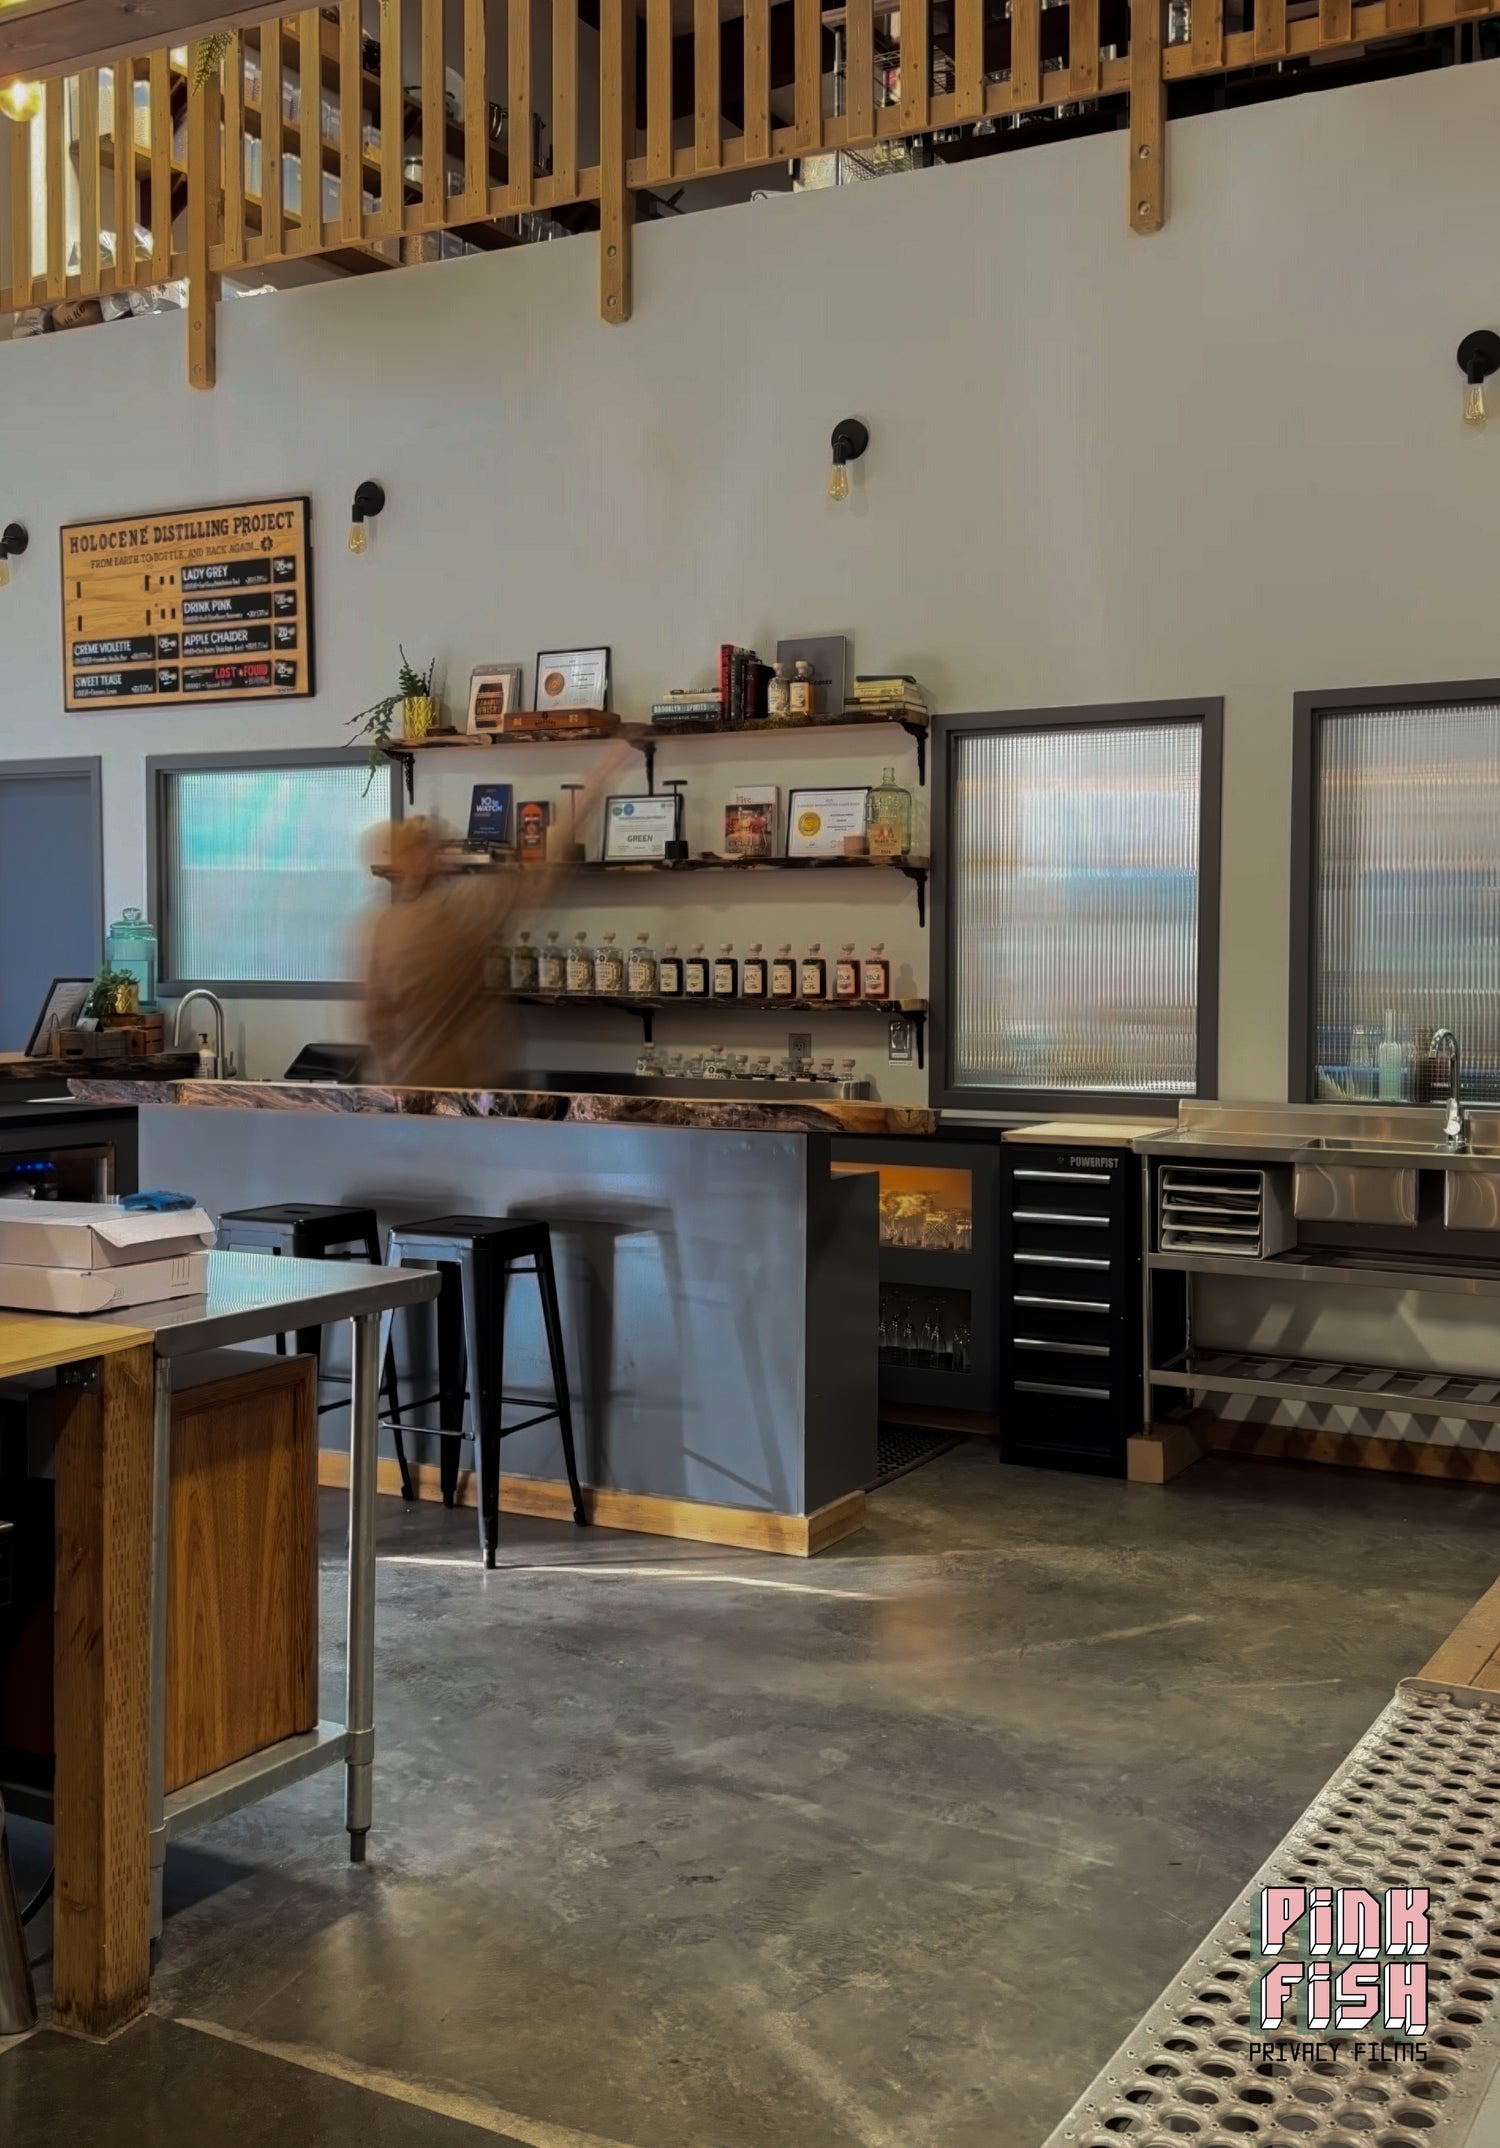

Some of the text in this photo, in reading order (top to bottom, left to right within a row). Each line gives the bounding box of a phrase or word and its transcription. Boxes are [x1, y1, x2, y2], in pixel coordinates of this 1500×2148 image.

[70, 511, 294, 554] HOLOCENE DISTILLING PROJECT
[91, 557, 112, 569] FROM
[189, 547, 204, 559] AND
[206, 545, 227, 556] BACK
[182, 564, 229, 581] LADY GREY
[183, 598, 233, 614] DRINK PINK
[184, 629, 248, 646] APPLE CHAIDER
[99, 640, 132, 653] VIOLETTE
[215, 666, 237, 679] LOST
[75, 673, 122, 688] SWEET TEASE
[654, 703, 681, 714] BROOKLYN
[476, 804, 502, 812] WATCH
[627, 834, 654, 843] GREEN
[1070, 1156, 1119, 1169] POWERFIST
